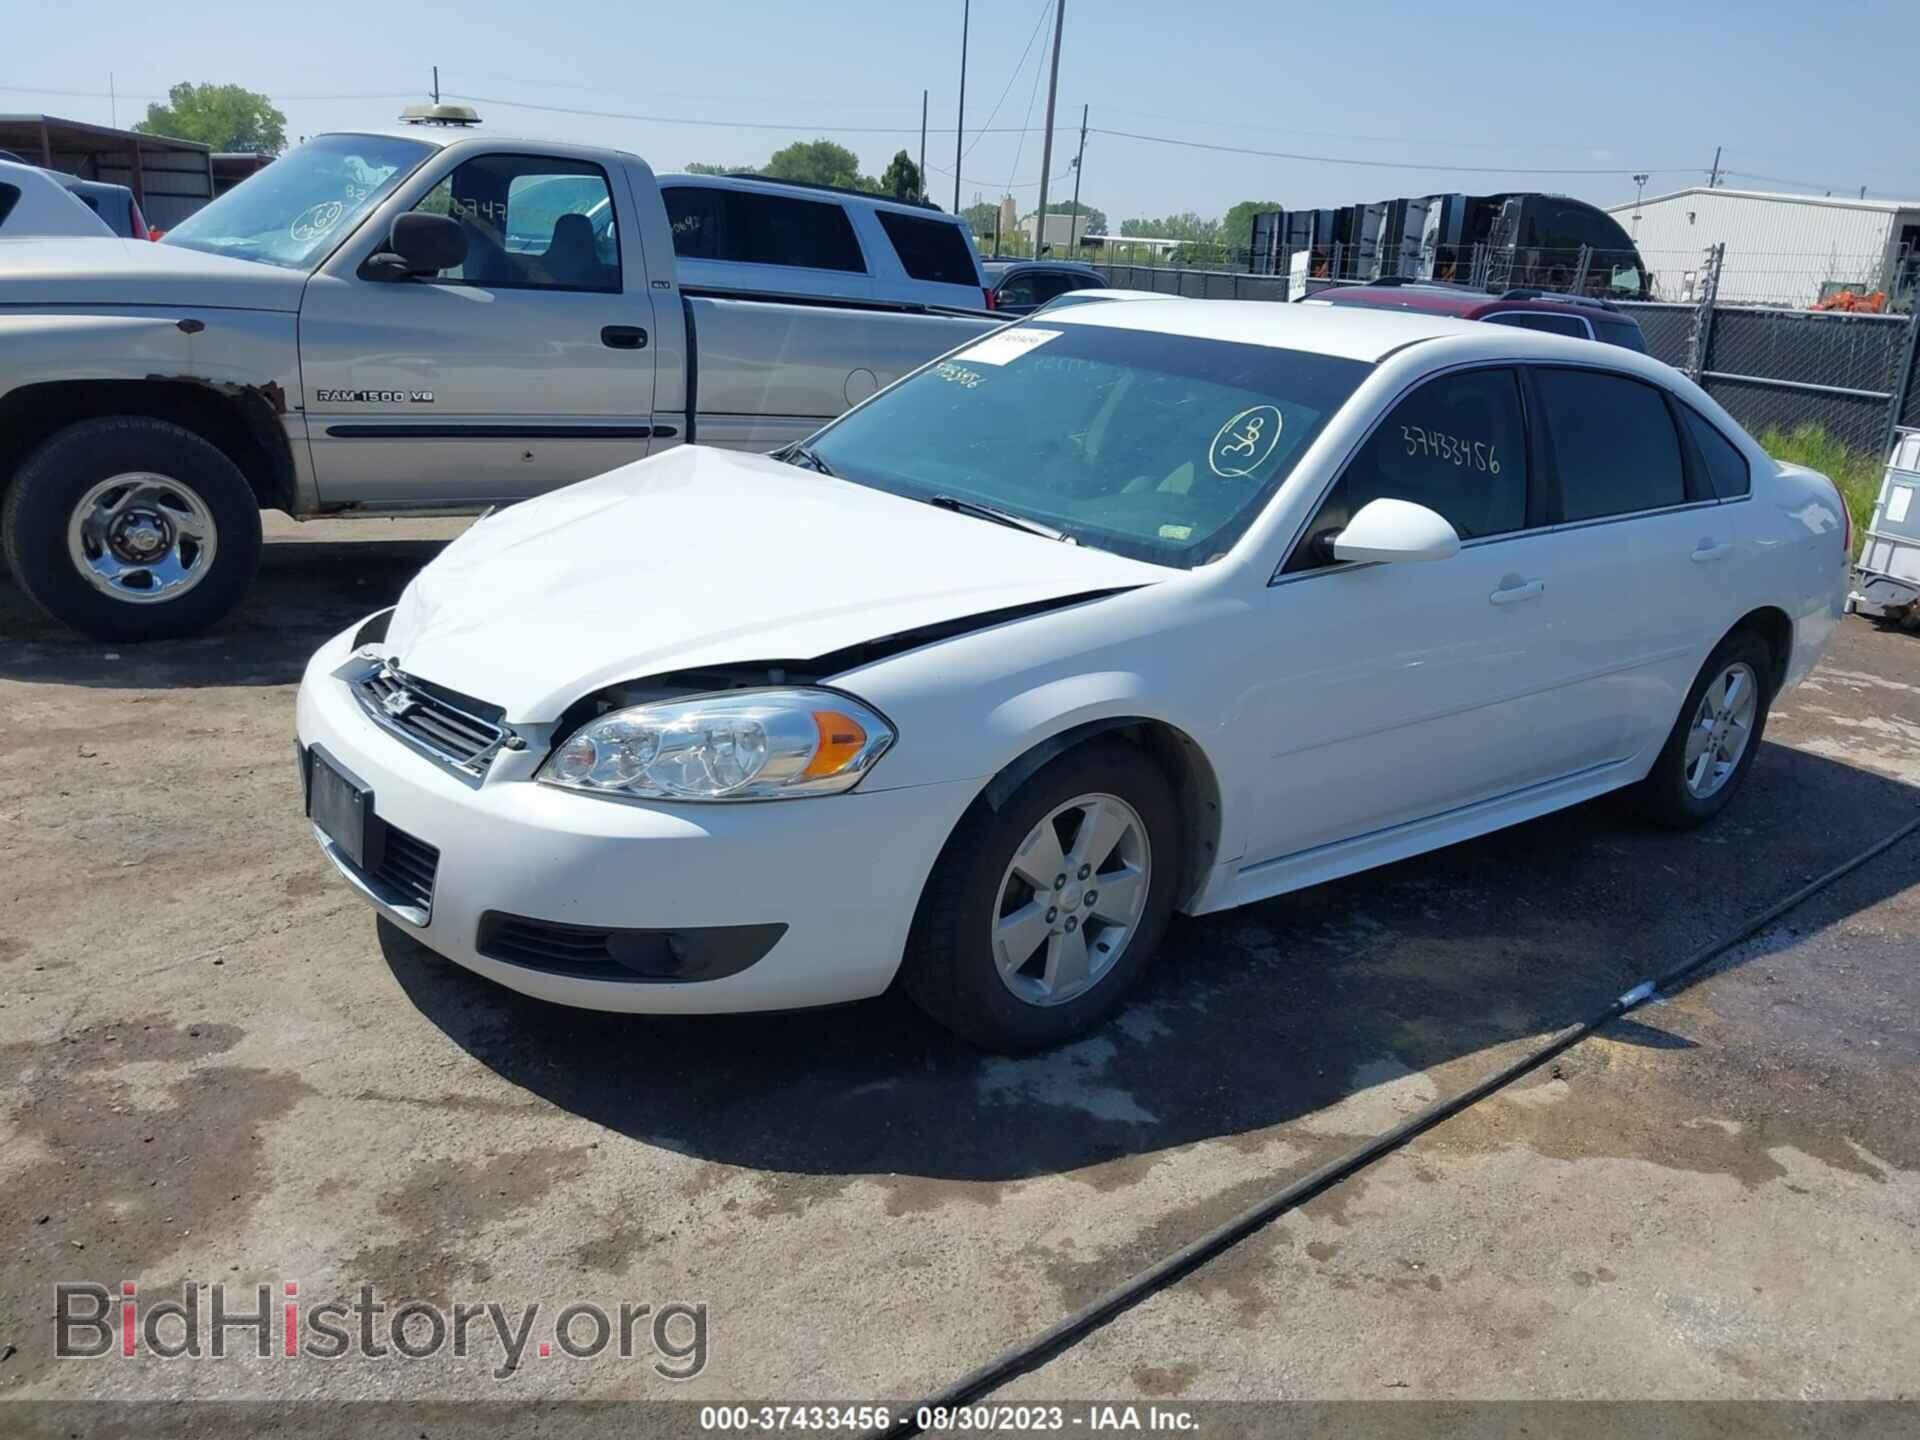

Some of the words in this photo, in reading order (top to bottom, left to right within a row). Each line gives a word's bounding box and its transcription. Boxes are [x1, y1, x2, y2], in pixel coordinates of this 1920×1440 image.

[296, 205, 338, 238] 360
[318, 390, 356, 401] RAM
[360, 390, 405, 402] 1500
[1220, 416, 1264, 457] 360
[1400, 425, 1500, 474] 37433456
